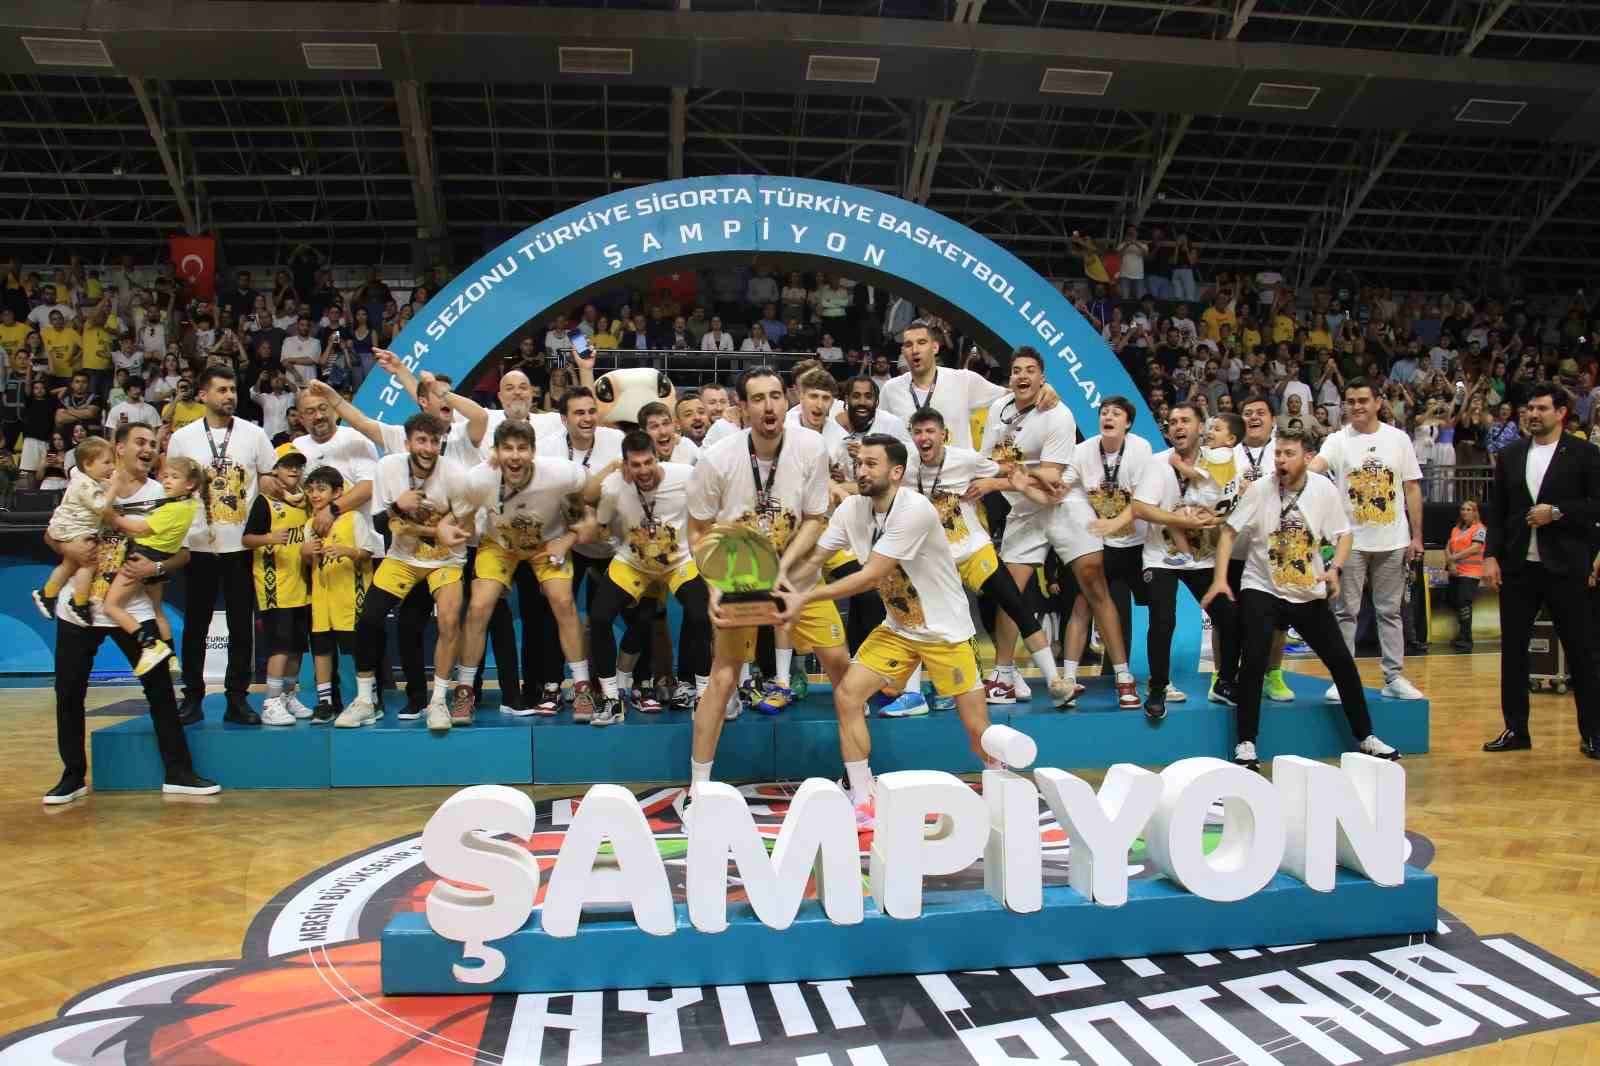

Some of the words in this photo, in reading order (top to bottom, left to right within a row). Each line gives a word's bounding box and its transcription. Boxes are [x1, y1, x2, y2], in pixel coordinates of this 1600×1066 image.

[427, 256, 519, 341] SEZONU
[519, 203, 631, 261] TÜRKİYE
[636, 188, 752, 215] SİGORTA
[760, 188, 874, 223] TÜRKİYE
[878, 212, 1015, 305] BASKETBOL
[1020, 302, 1064, 348] LİGİ
[604, 218, 886, 269] ŞAMPİYON
[423, 724, 1407, 984] ŞAMPİYON
[299, 903, 338, 943] MERSİN
